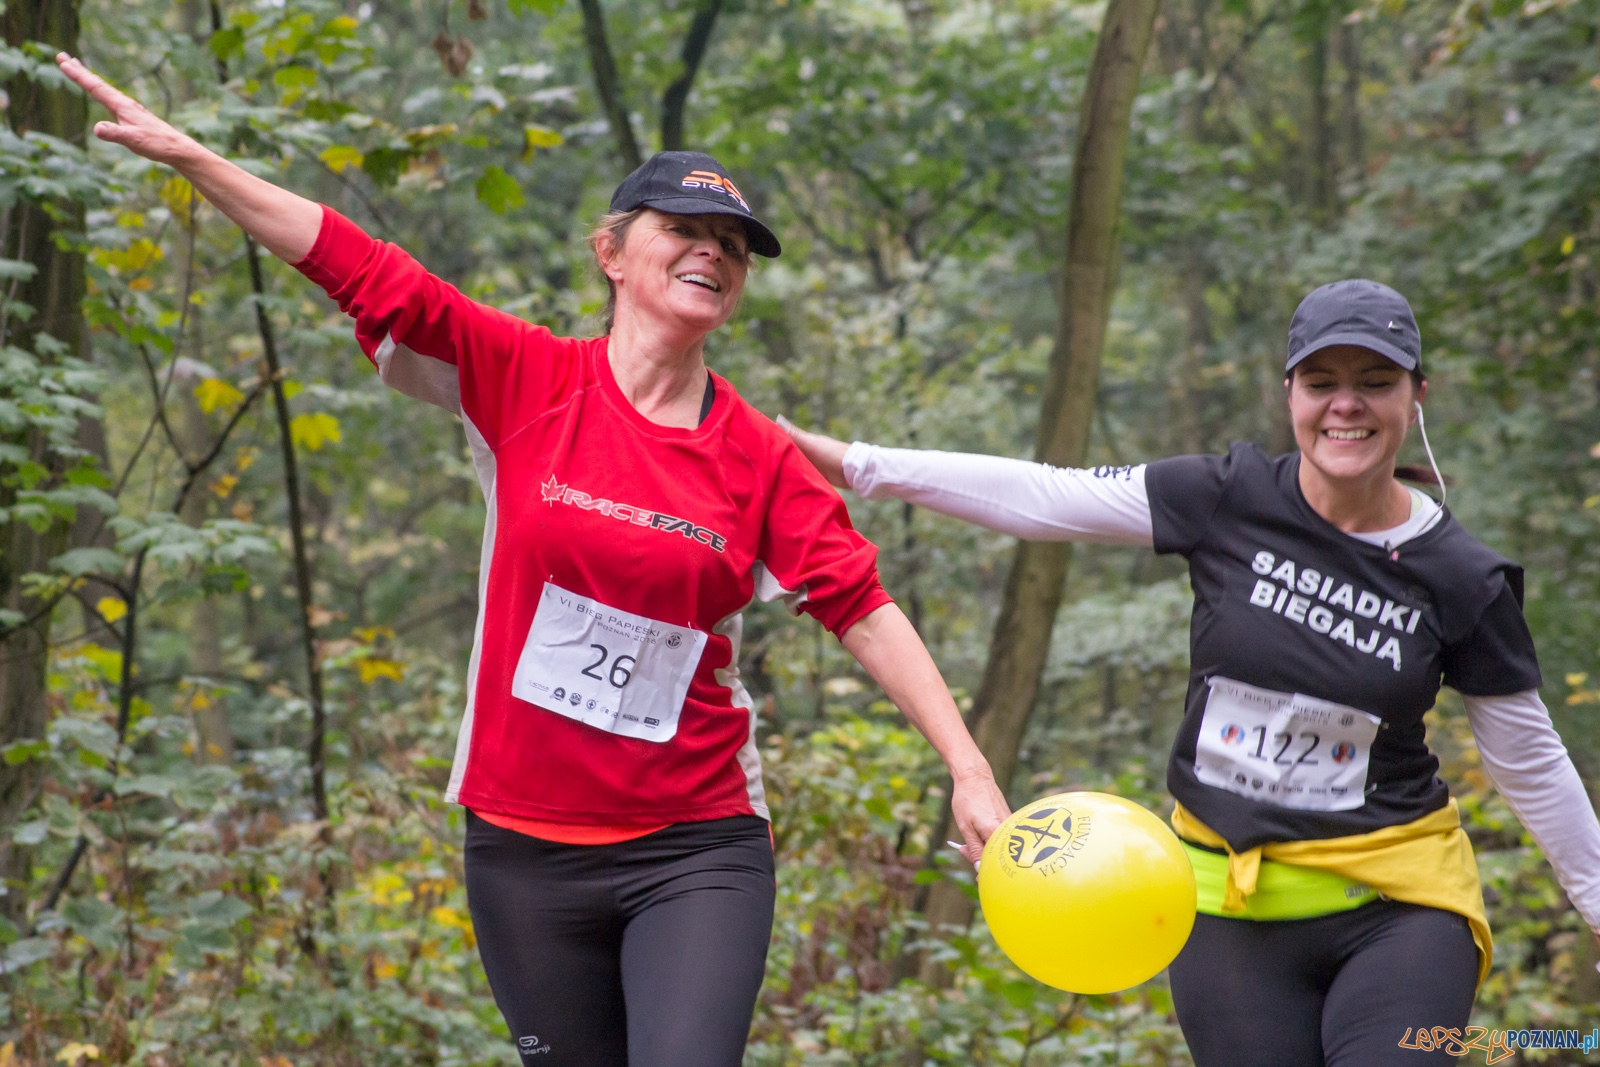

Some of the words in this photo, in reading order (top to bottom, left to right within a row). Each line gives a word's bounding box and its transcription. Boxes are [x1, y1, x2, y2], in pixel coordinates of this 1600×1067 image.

[563, 488, 727, 552] RACEFACE
[560, 596, 571, 608] VI
[577, 603, 603, 621] BIEG
[608, 616, 660, 638] PAPIESKI
[1252, 551, 1421, 634] SĄSIADKI
[1250, 579, 1401, 671] BIEGAJĄ
[581, 643, 636, 689] 26
[1247, 723, 1320, 766] 122
[1038, 815, 1092, 878] FUNDACJA
